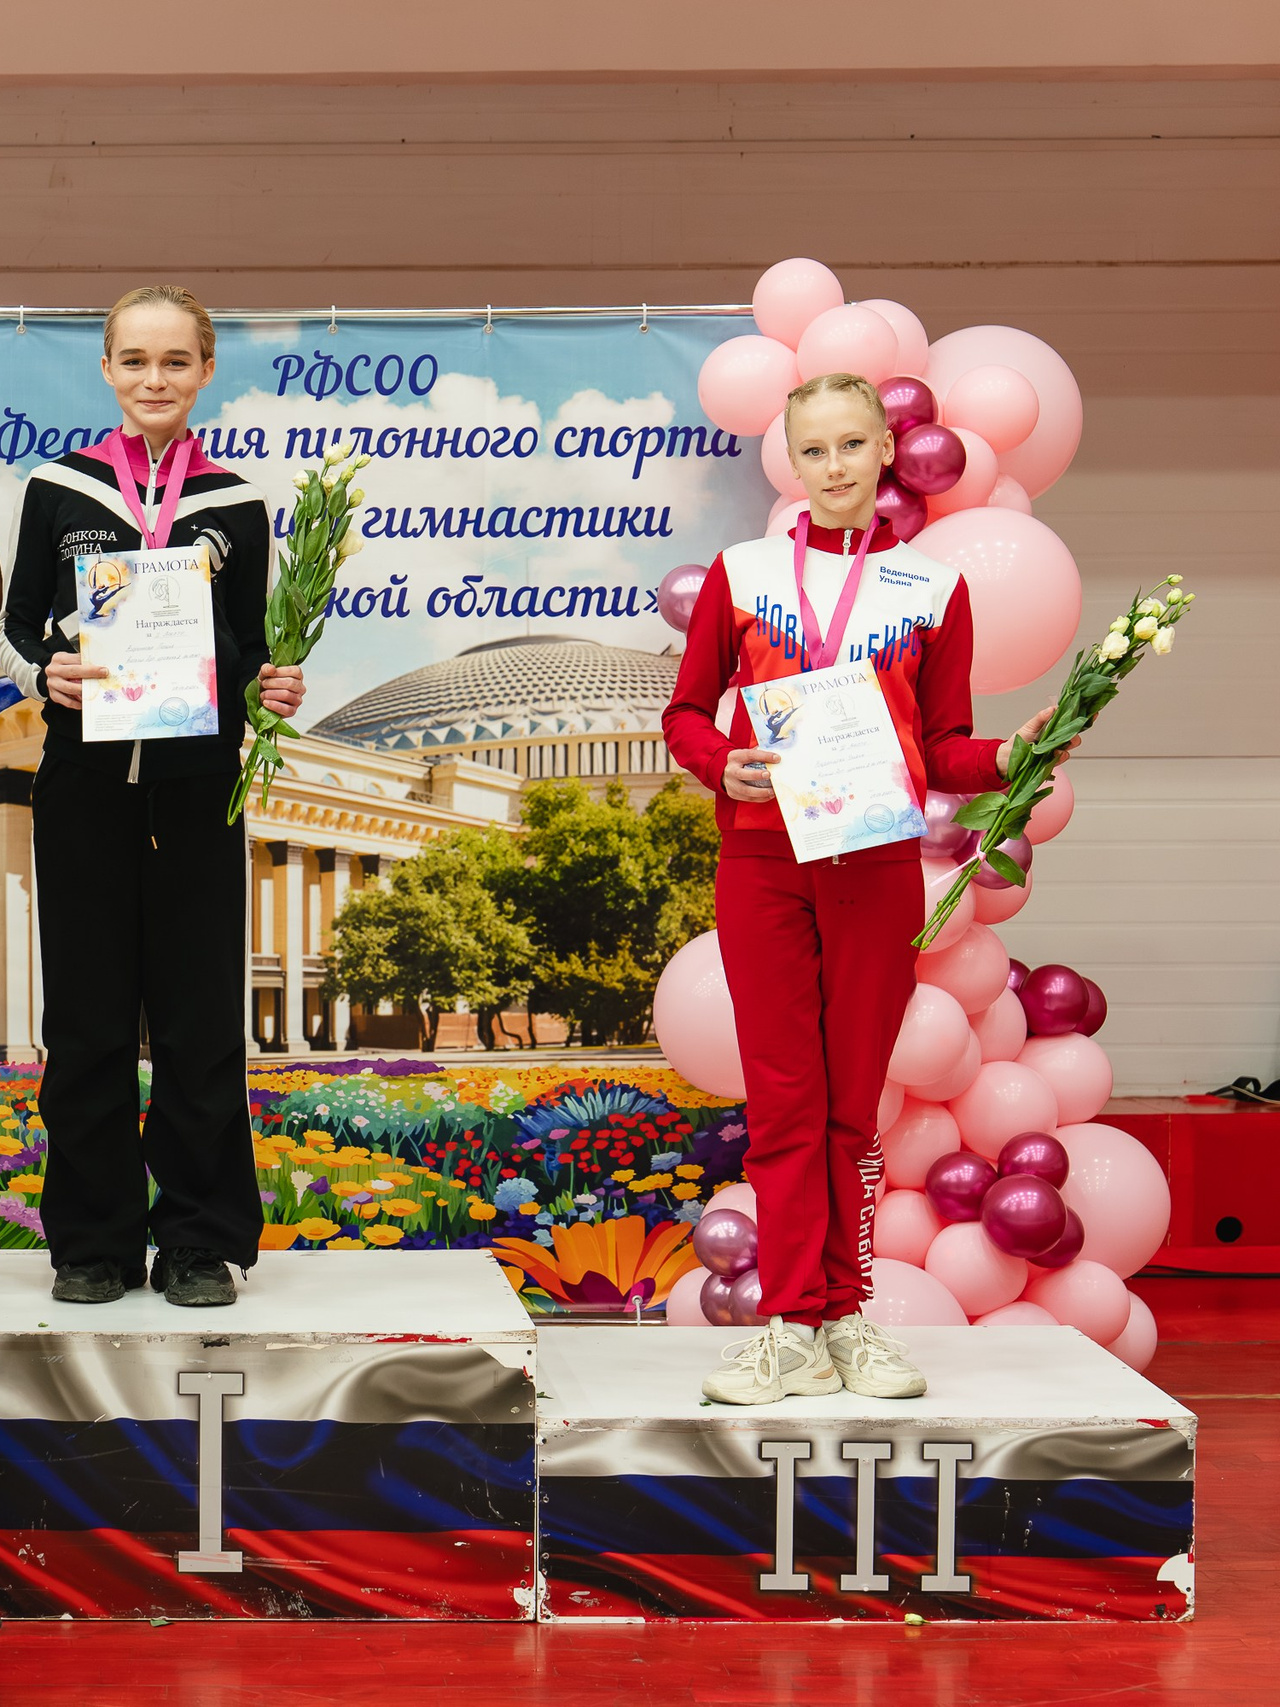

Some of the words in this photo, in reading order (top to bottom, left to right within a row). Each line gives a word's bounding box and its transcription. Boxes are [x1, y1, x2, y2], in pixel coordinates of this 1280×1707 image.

[272, 350, 440, 400] РФСОО
[284, 427, 539, 459] пилонного
[554, 427, 742, 479] спорта
[362, 507, 673, 539] гимнастики
[58, 530, 118, 548] ОНКОВА
[134, 558, 200, 575] ГРАМОТА
[880, 566, 930, 583] Веденцова
[879, 574, 912, 587] Ульяна
[135, 618, 199, 631] Награждается
[802, 672, 867, 695] ГРАМОТА
[817, 726, 880, 745] Награждается
[178, 1372, 244, 1573] I
[759, 1441, 973, 1592] III
